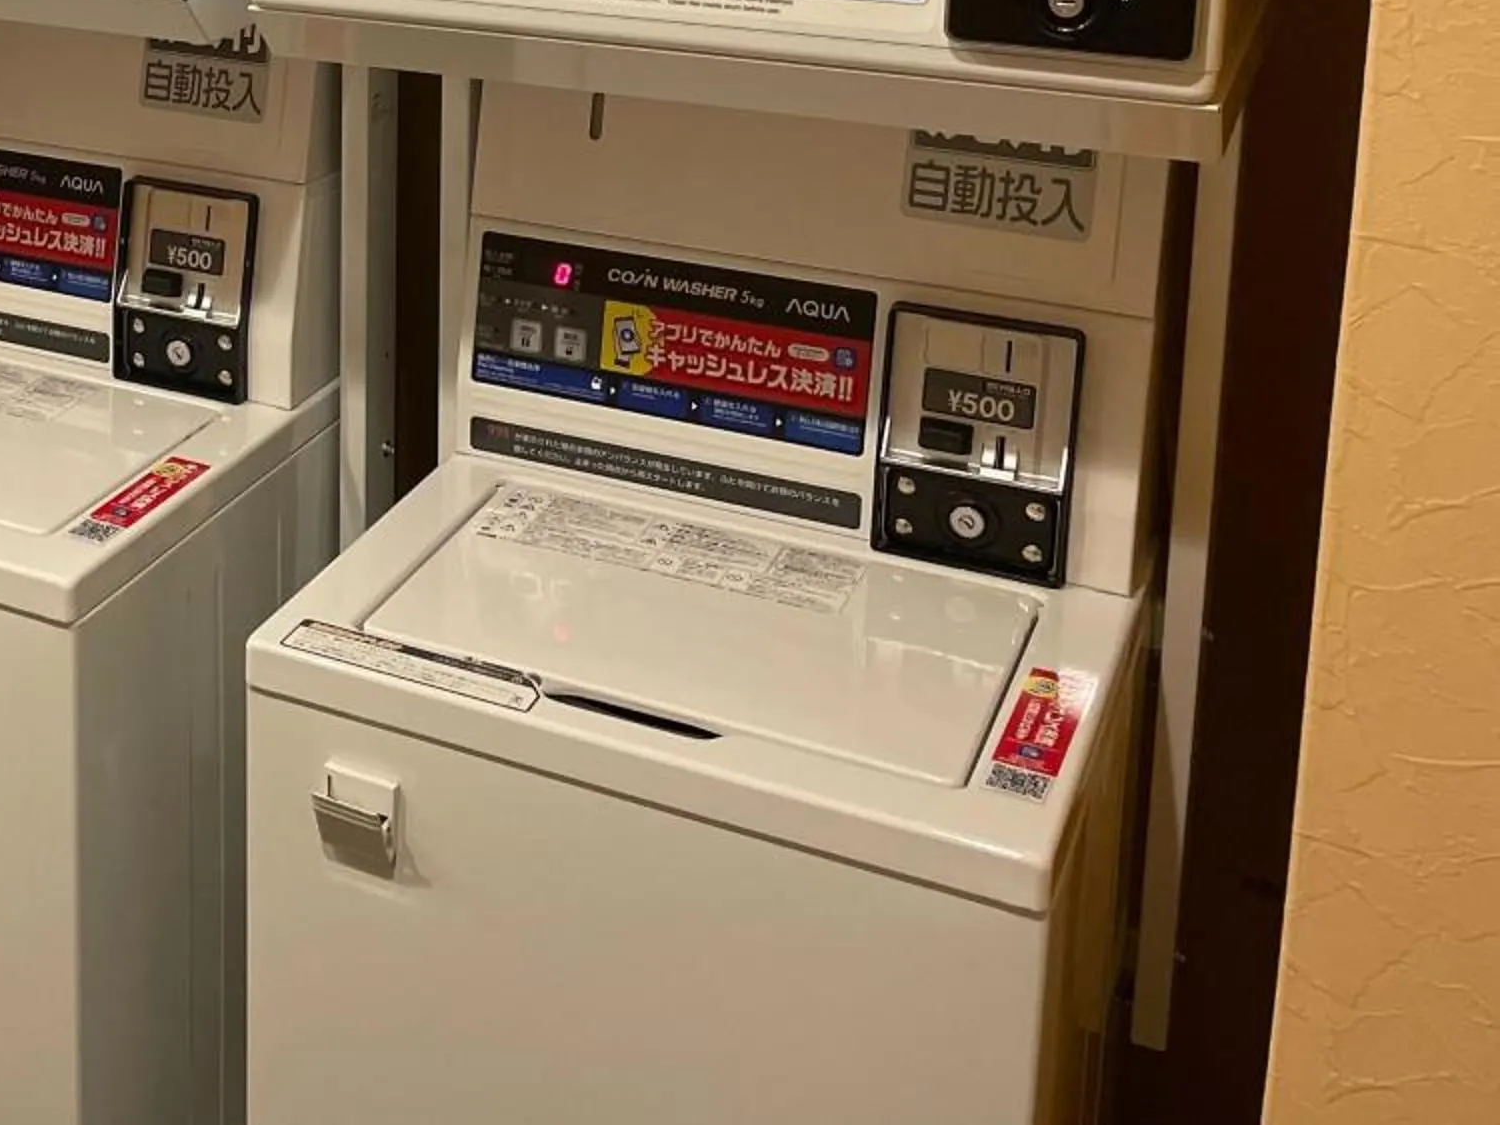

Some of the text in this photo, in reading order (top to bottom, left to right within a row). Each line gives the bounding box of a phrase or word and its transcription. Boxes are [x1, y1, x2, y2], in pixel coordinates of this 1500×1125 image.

[144, 59, 262, 116] 自動投入
[60, 174, 104, 195] AQUA
[908, 158, 1085, 232] 自動投入
[166, 244, 213, 271] ¥500
[554, 262, 573, 287] 0
[607, 266, 658, 289] COIN
[663, 277, 738, 302] WASHER
[785, 297, 851, 323] AQUA
[650, 319, 782, 359] アプリでかんたん
[947, 388, 1015, 422] ¥500
